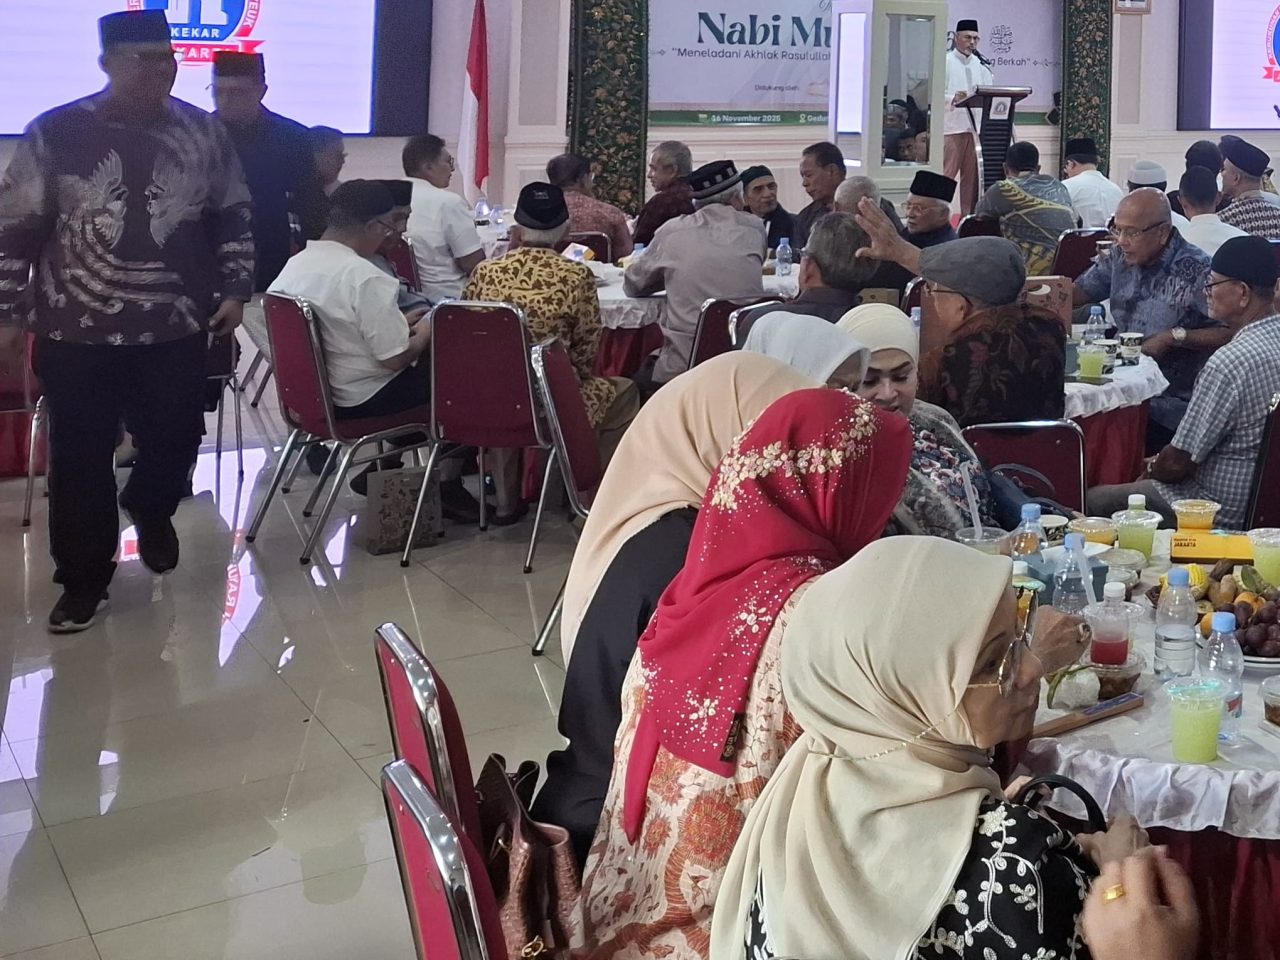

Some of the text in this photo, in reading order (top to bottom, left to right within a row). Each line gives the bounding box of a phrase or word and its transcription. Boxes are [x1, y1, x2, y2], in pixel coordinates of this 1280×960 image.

[171, 26, 220, 38] KEKAR
[697, 11, 781, 46] Nabi
[671, 47, 741, 59] "Meneladani
[743, 51, 779, 60] Akhlak
[997, 57, 1030, 66] Berkah"
